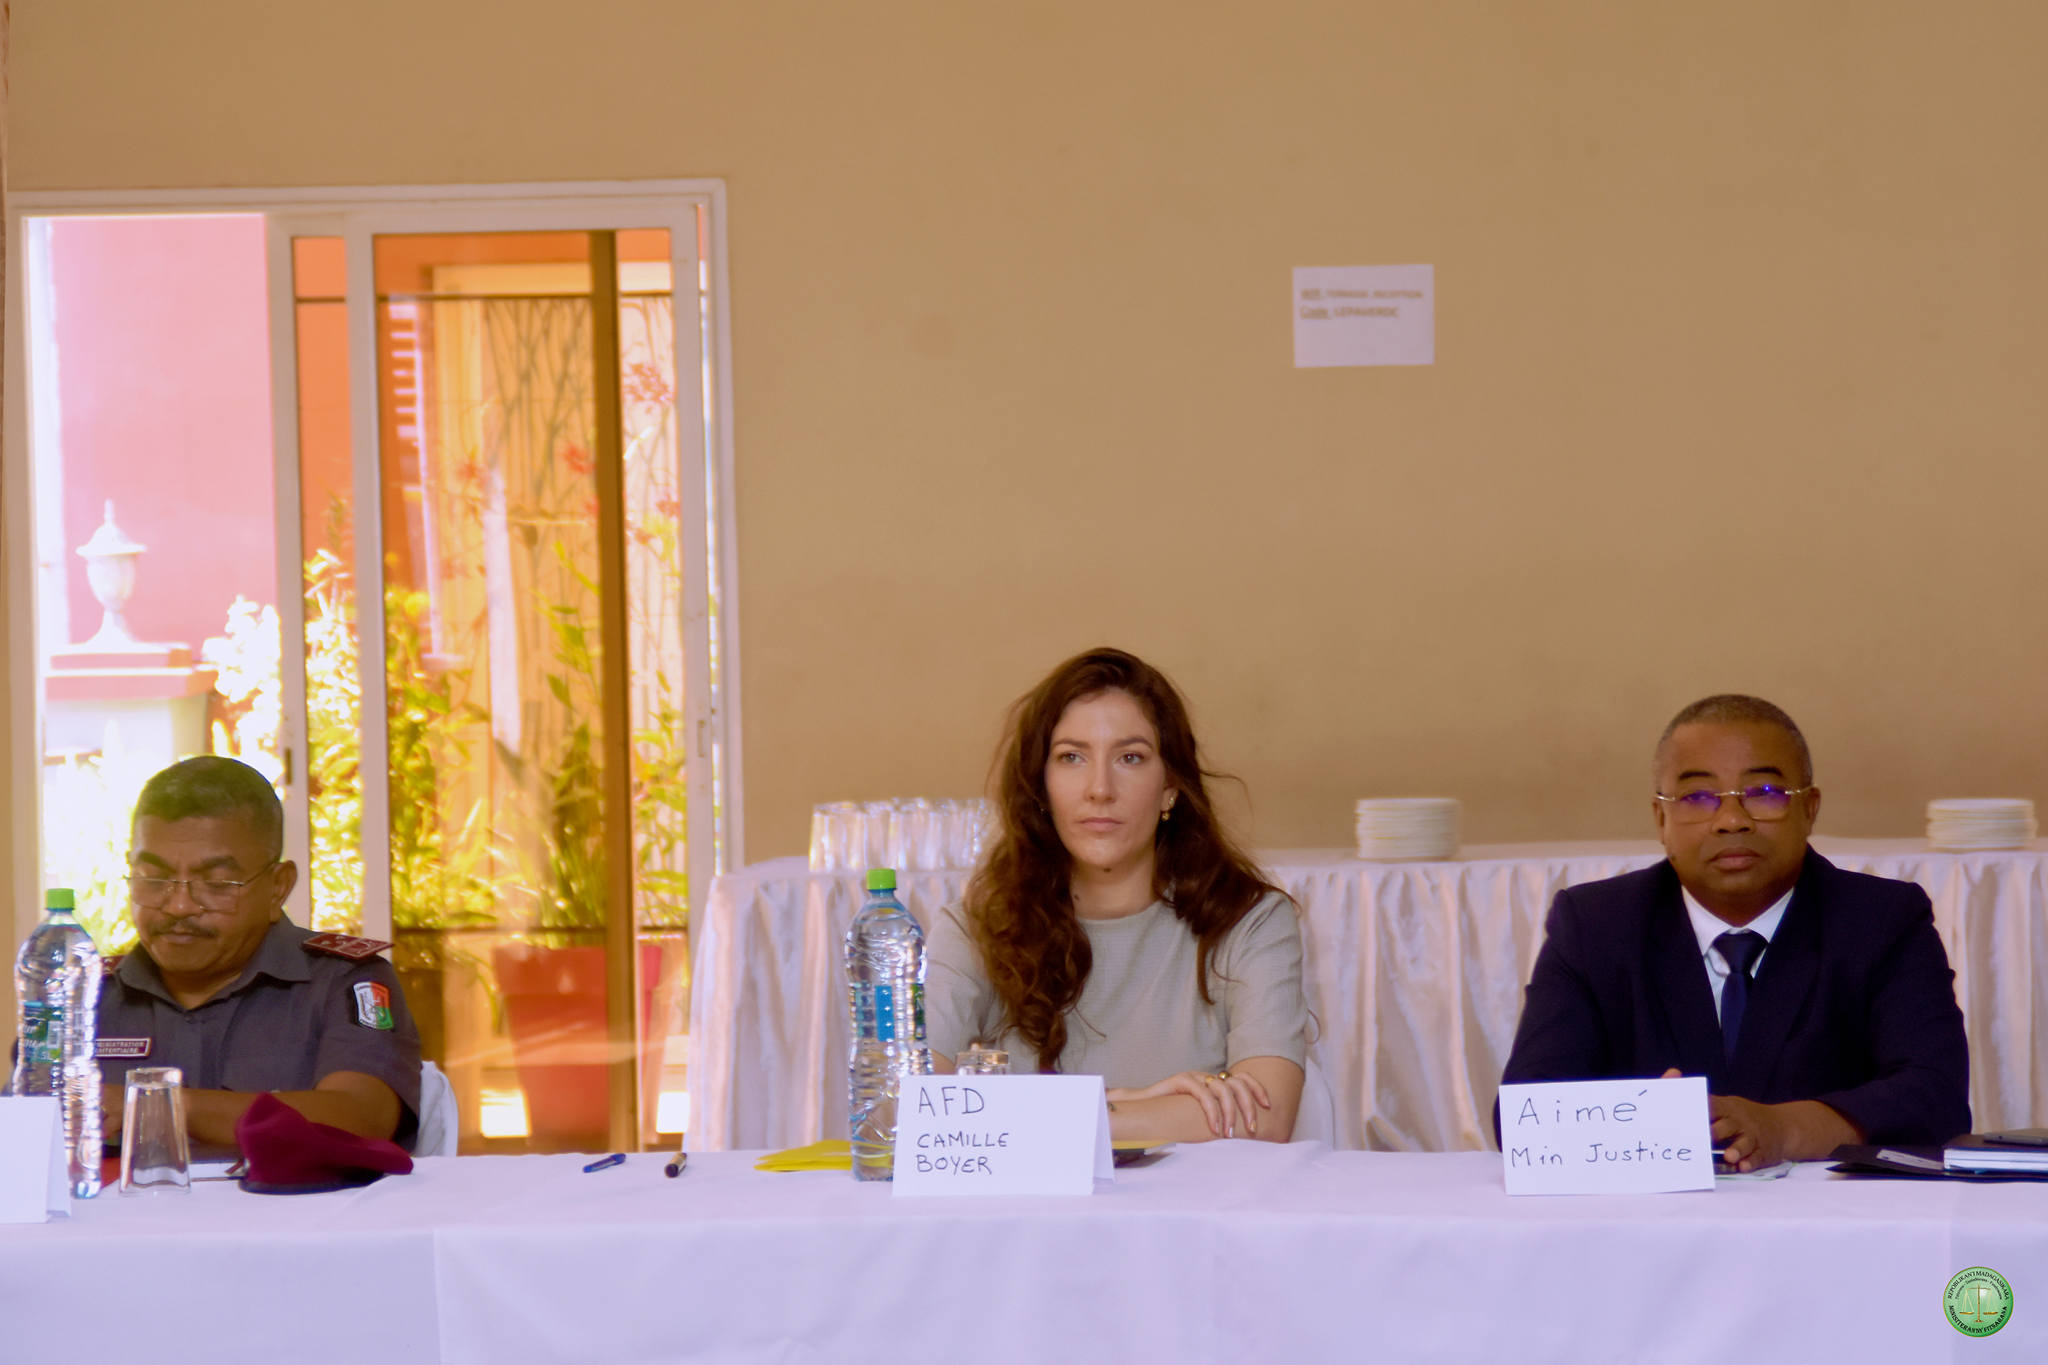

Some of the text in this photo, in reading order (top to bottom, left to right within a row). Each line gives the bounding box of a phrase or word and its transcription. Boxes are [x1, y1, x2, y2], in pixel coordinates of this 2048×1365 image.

[918, 1085, 985, 1117] AFD
[1517, 1089, 1648, 1126] Aimé
[916, 1130, 1009, 1149] CAMILLE
[916, 1154, 993, 1176] BOYER
[1511, 1140, 1692, 1168] Min Justice
